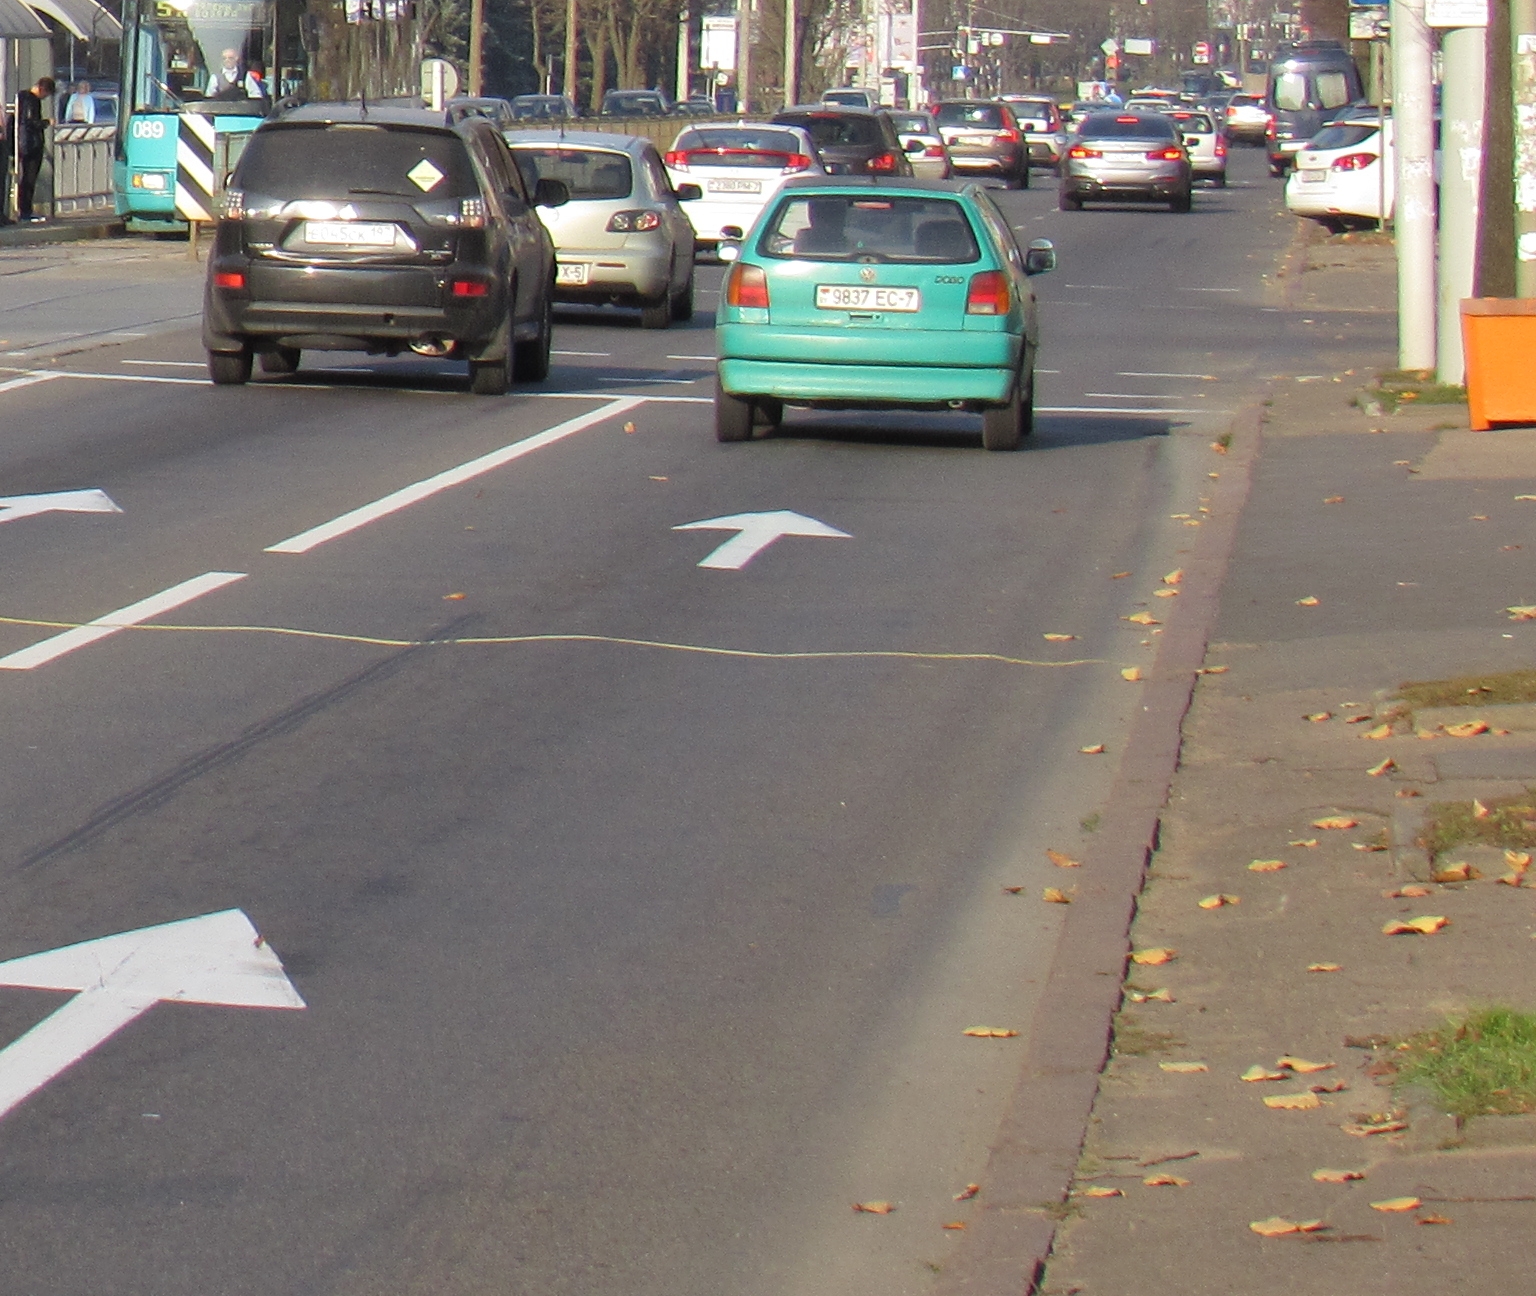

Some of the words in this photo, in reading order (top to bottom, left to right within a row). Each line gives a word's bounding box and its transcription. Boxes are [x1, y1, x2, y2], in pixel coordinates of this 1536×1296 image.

[133, 120, 164, 139] 089
[561, 266, 582, 280] X-5
[832, 288, 870, 305] 9837
[875, 290, 915, 308] EC-7
